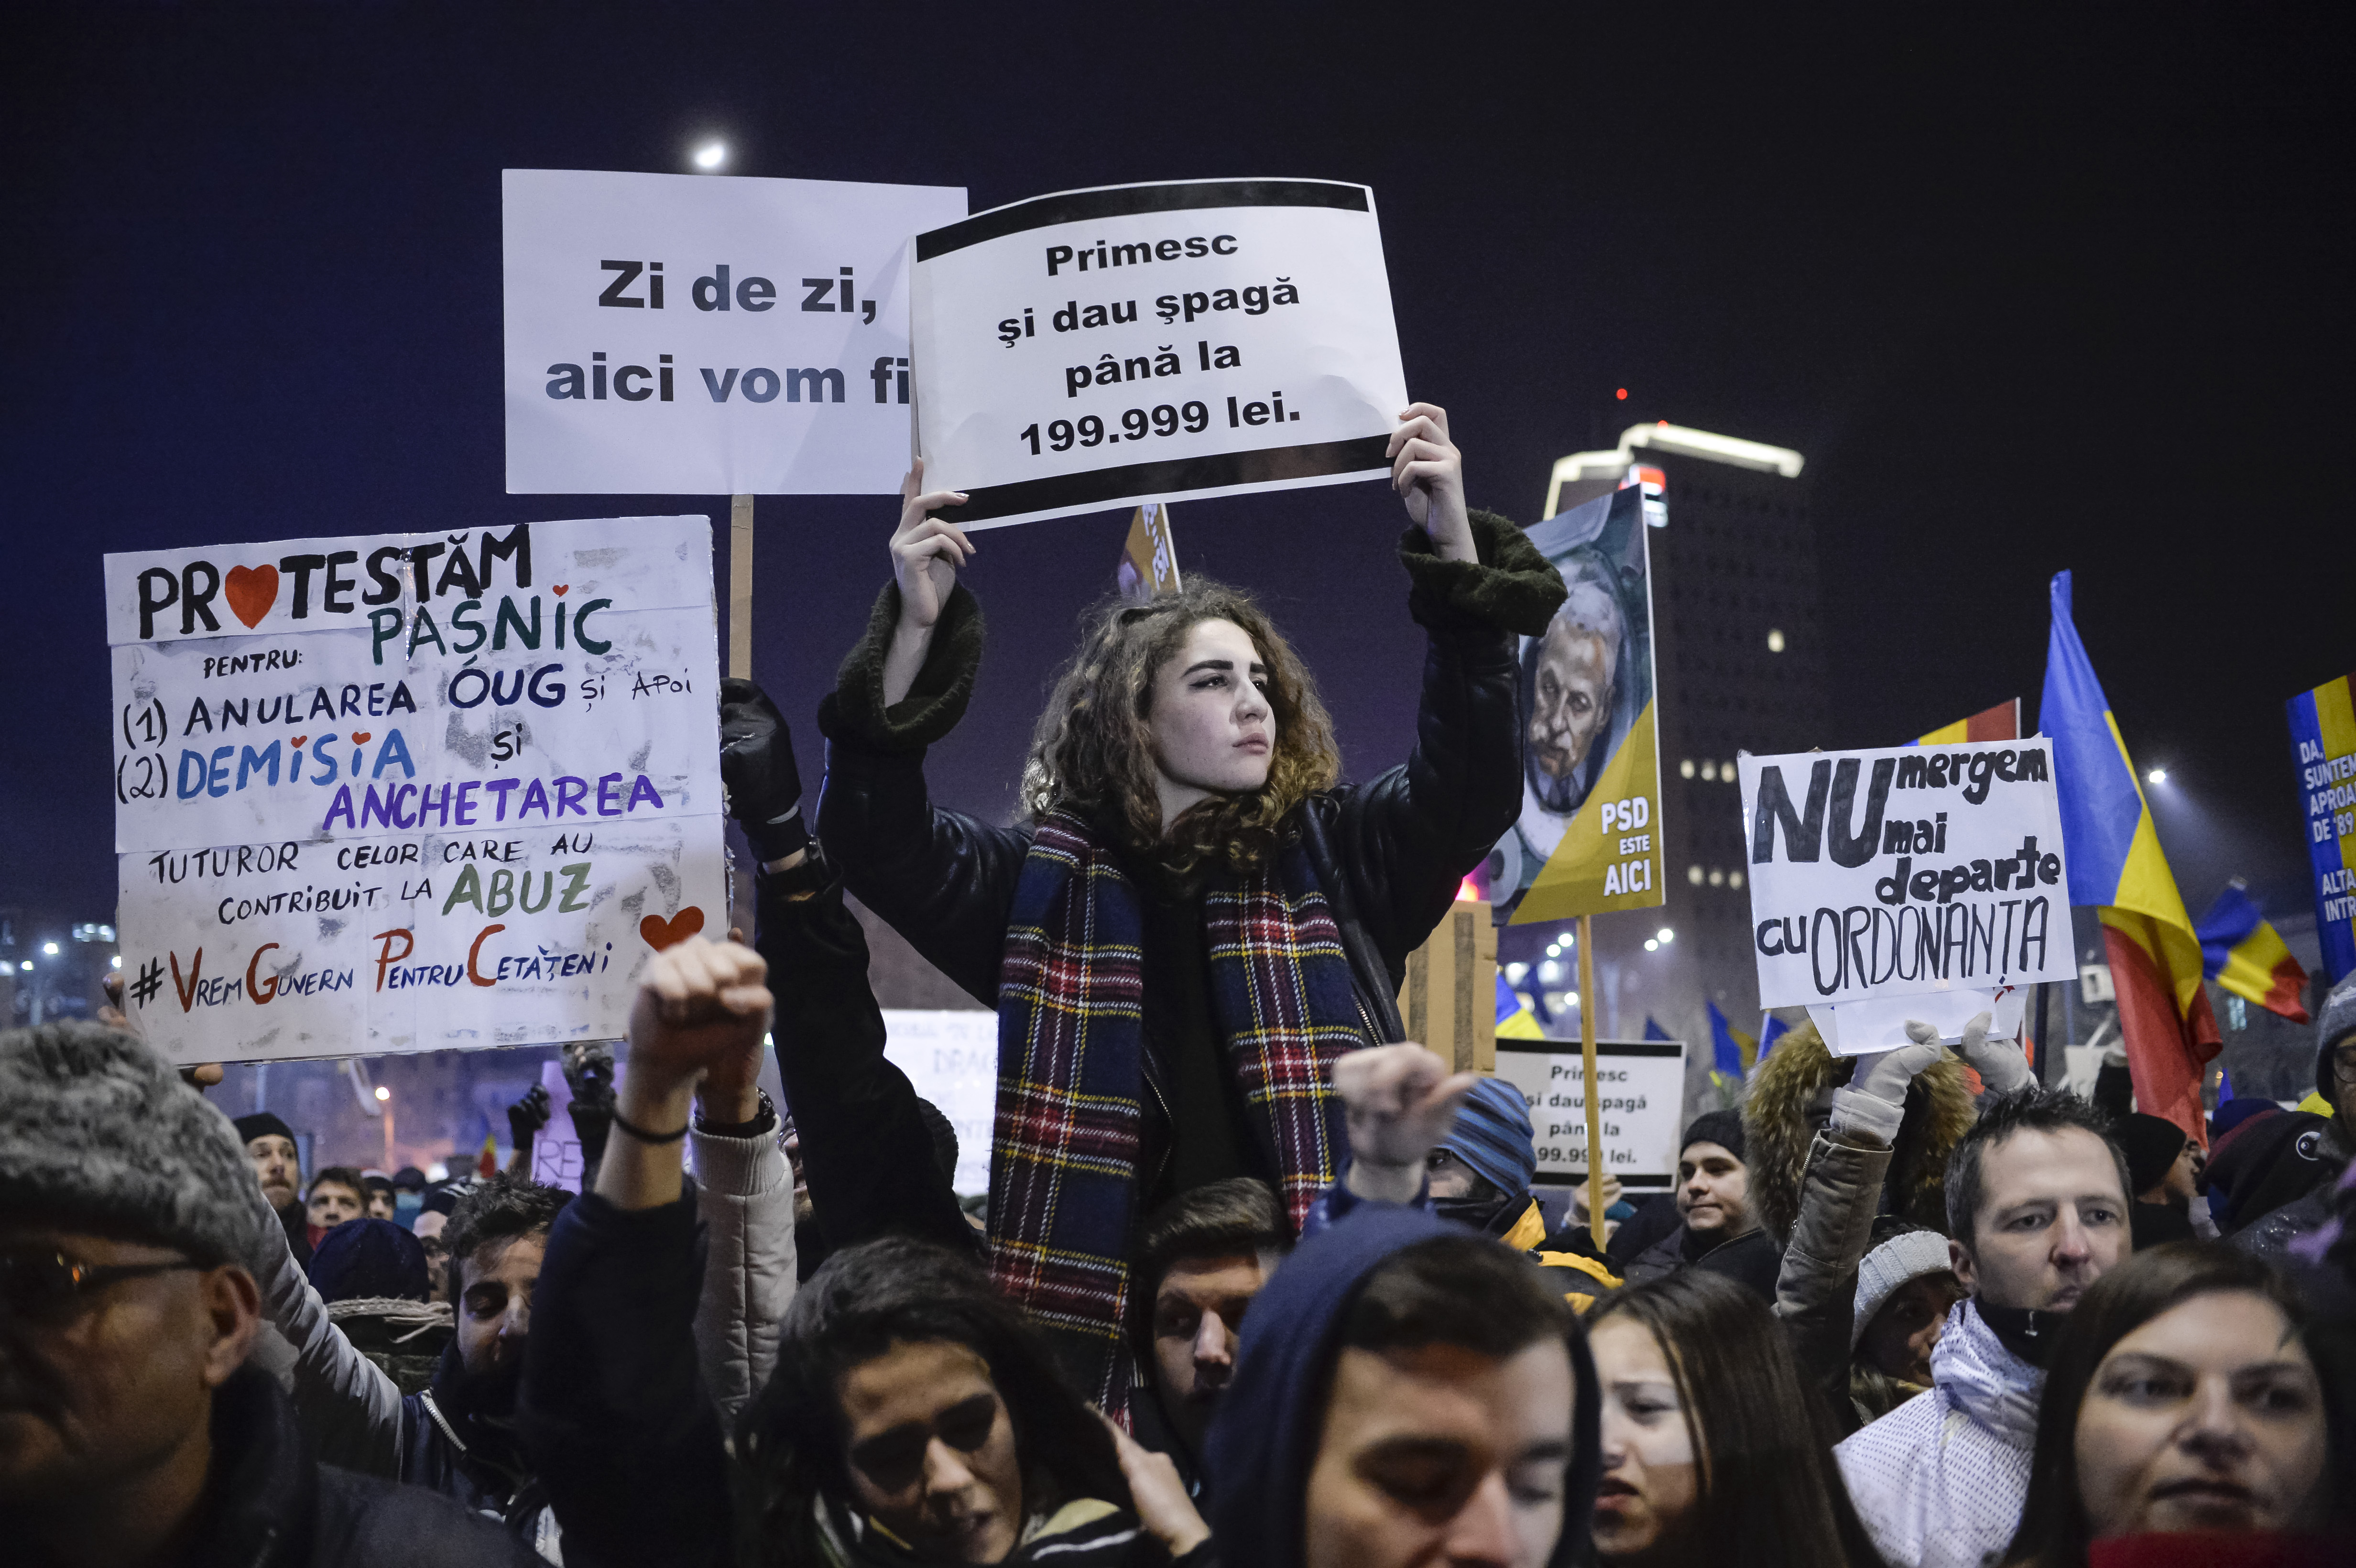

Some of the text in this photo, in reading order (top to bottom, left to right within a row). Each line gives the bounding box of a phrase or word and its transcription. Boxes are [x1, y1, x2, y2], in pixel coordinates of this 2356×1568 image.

[1046, 234, 1238, 276] Primesc
[599, 260, 876, 326] Zi de zi,
[1052, 300, 1137, 333] dau
[545, 352, 910, 404] aici vom fi
[1065, 340, 1242, 398] până la
[1020, 391, 1300, 456] 199.999 lei.
[204, 650, 302, 679] PENTRU:
[123, 698, 168, 750] (1)
[184, 680, 416, 736] ANULAREA
[117, 753, 168, 804] (2)
[2310, 781, 2356, 816] APROA
[322, 772, 664, 830] ANCHETAREA
[1601, 796, 1649, 835] PSD
[1752, 748, 2048, 868] NU mergem
[1619, 834, 1650, 855] ESTE
[1882, 812, 1948, 855] mai
[2312, 818, 2332, 843] DE
[149, 833, 593, 884] TUTUROR CELOR CARE AU
[1603, 859, 1651, 897] AICI
[1875, 836, 2061, 905] departe
[401, 878, 432, 900] LA
[442, 862, 592, 917] ABUZ
[1549, 1094, 1584, 1108] dau
[1599, 1094, 1647, 1113] pagă
[1549, 1121, 1620, 1138] pân la
[1538, 1147, 1603, 1163] 99.99
